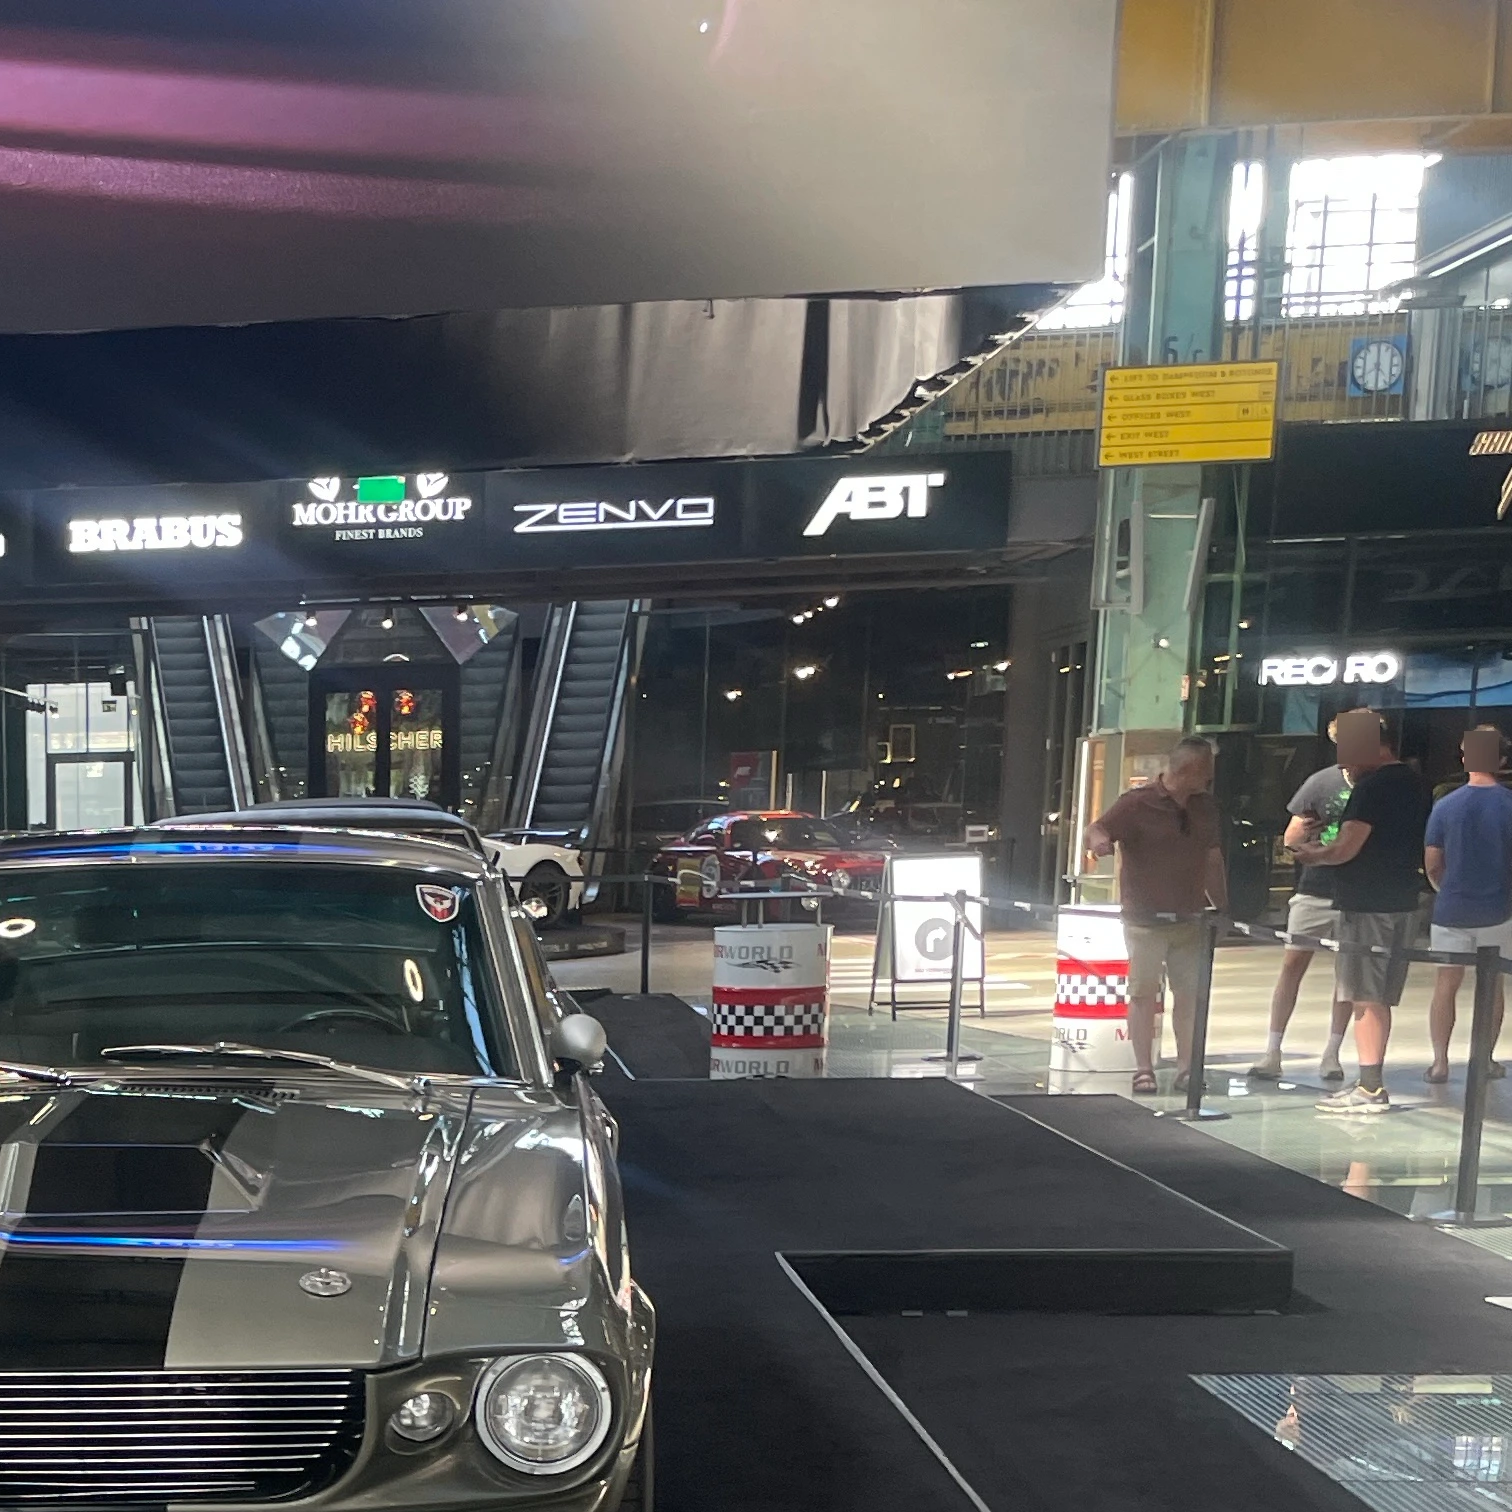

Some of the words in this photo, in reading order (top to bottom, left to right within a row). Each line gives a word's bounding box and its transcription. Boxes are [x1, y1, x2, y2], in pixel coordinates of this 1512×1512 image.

[1144, 430, 1169, 439] WEST
[1118, 450, 1144, 459] WEST
[377, 497, 472, 522] GROUP
[513, 497, 714, 533] ZENVO
[803, 473, 945, 536] ABT
[68, 513, 243, 553] BRABUS
[335, 529, 376, 541] FINEST
[378, 526, 424, 540] BRANDS
[1258, 654, 1398, 685] RECRO
